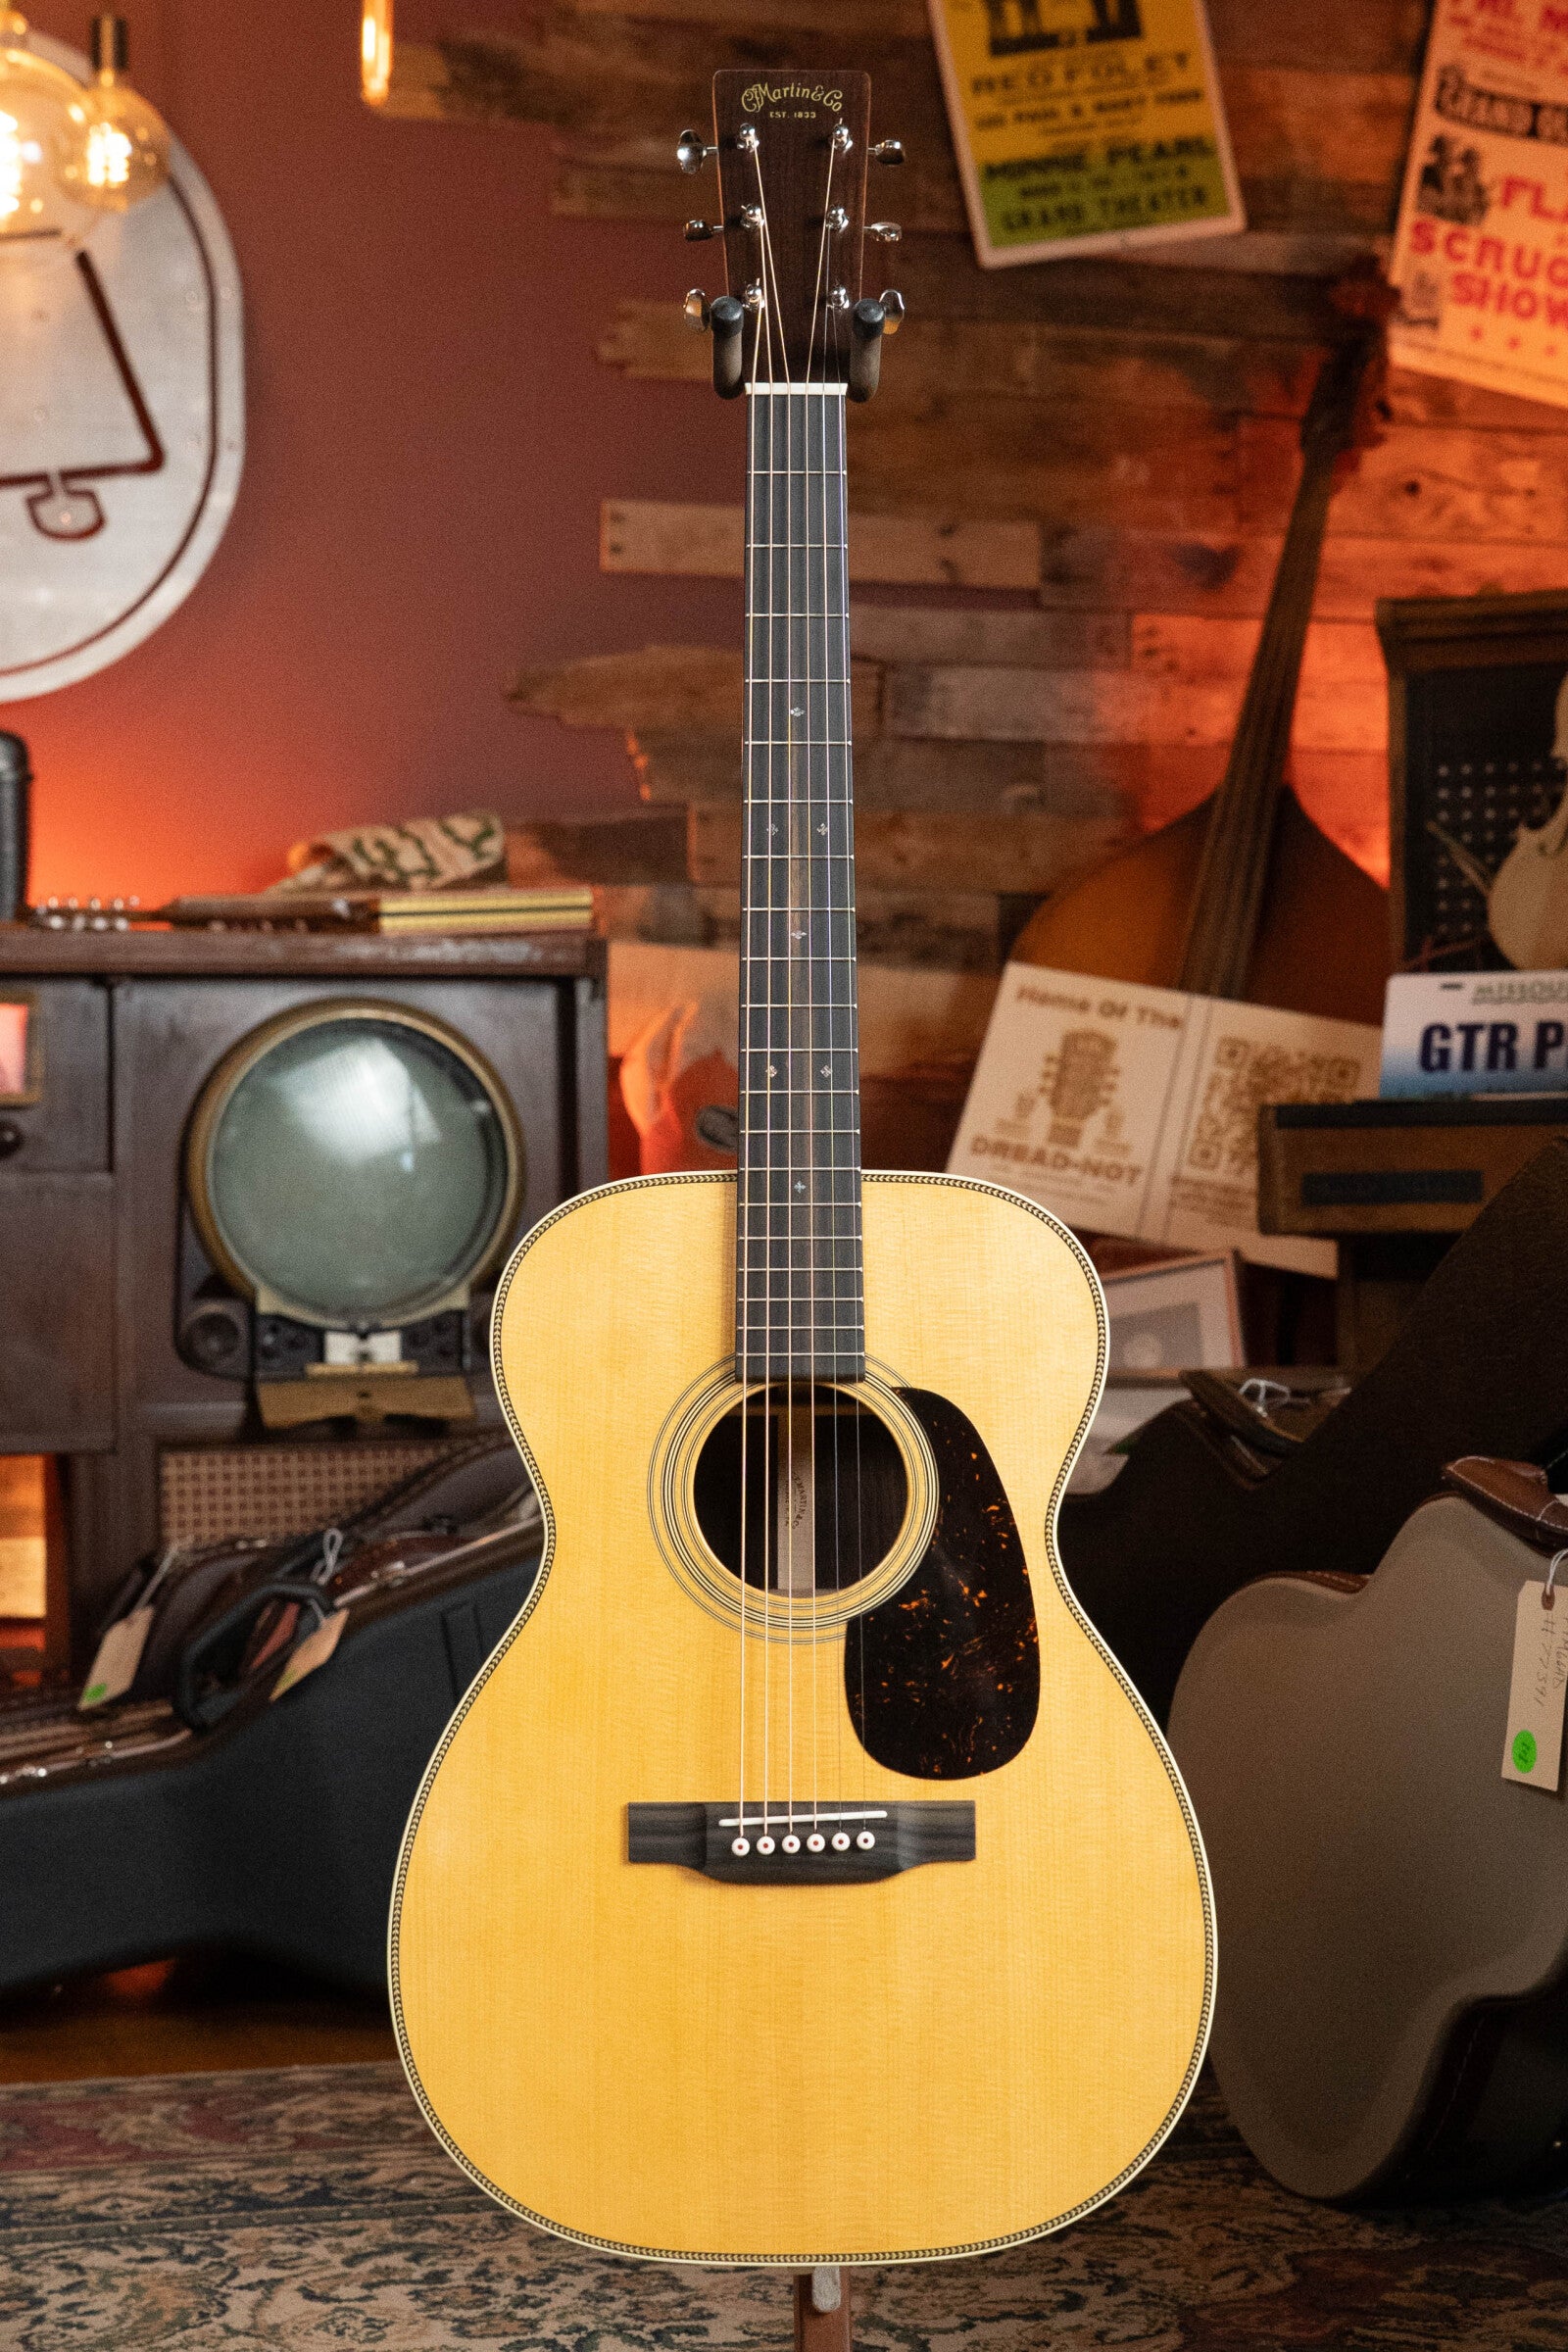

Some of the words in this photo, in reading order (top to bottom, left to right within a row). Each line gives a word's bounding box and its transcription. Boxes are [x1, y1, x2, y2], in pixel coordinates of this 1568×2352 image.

[1500, 175, 1568, 222] FL
[1016, 986, 1092, 1012] Home
[1098, 1000, 1129, 1019] Of
[1135, 1005, 1183, 1030] The
[1474, 980, 1568, 1004] MISSOU
[1419, 1021, 1519, 1072] GTR
[1532, 1019, 1568, 1071] P
[970, 1134, 1144, 1185] DREAD-NOT
